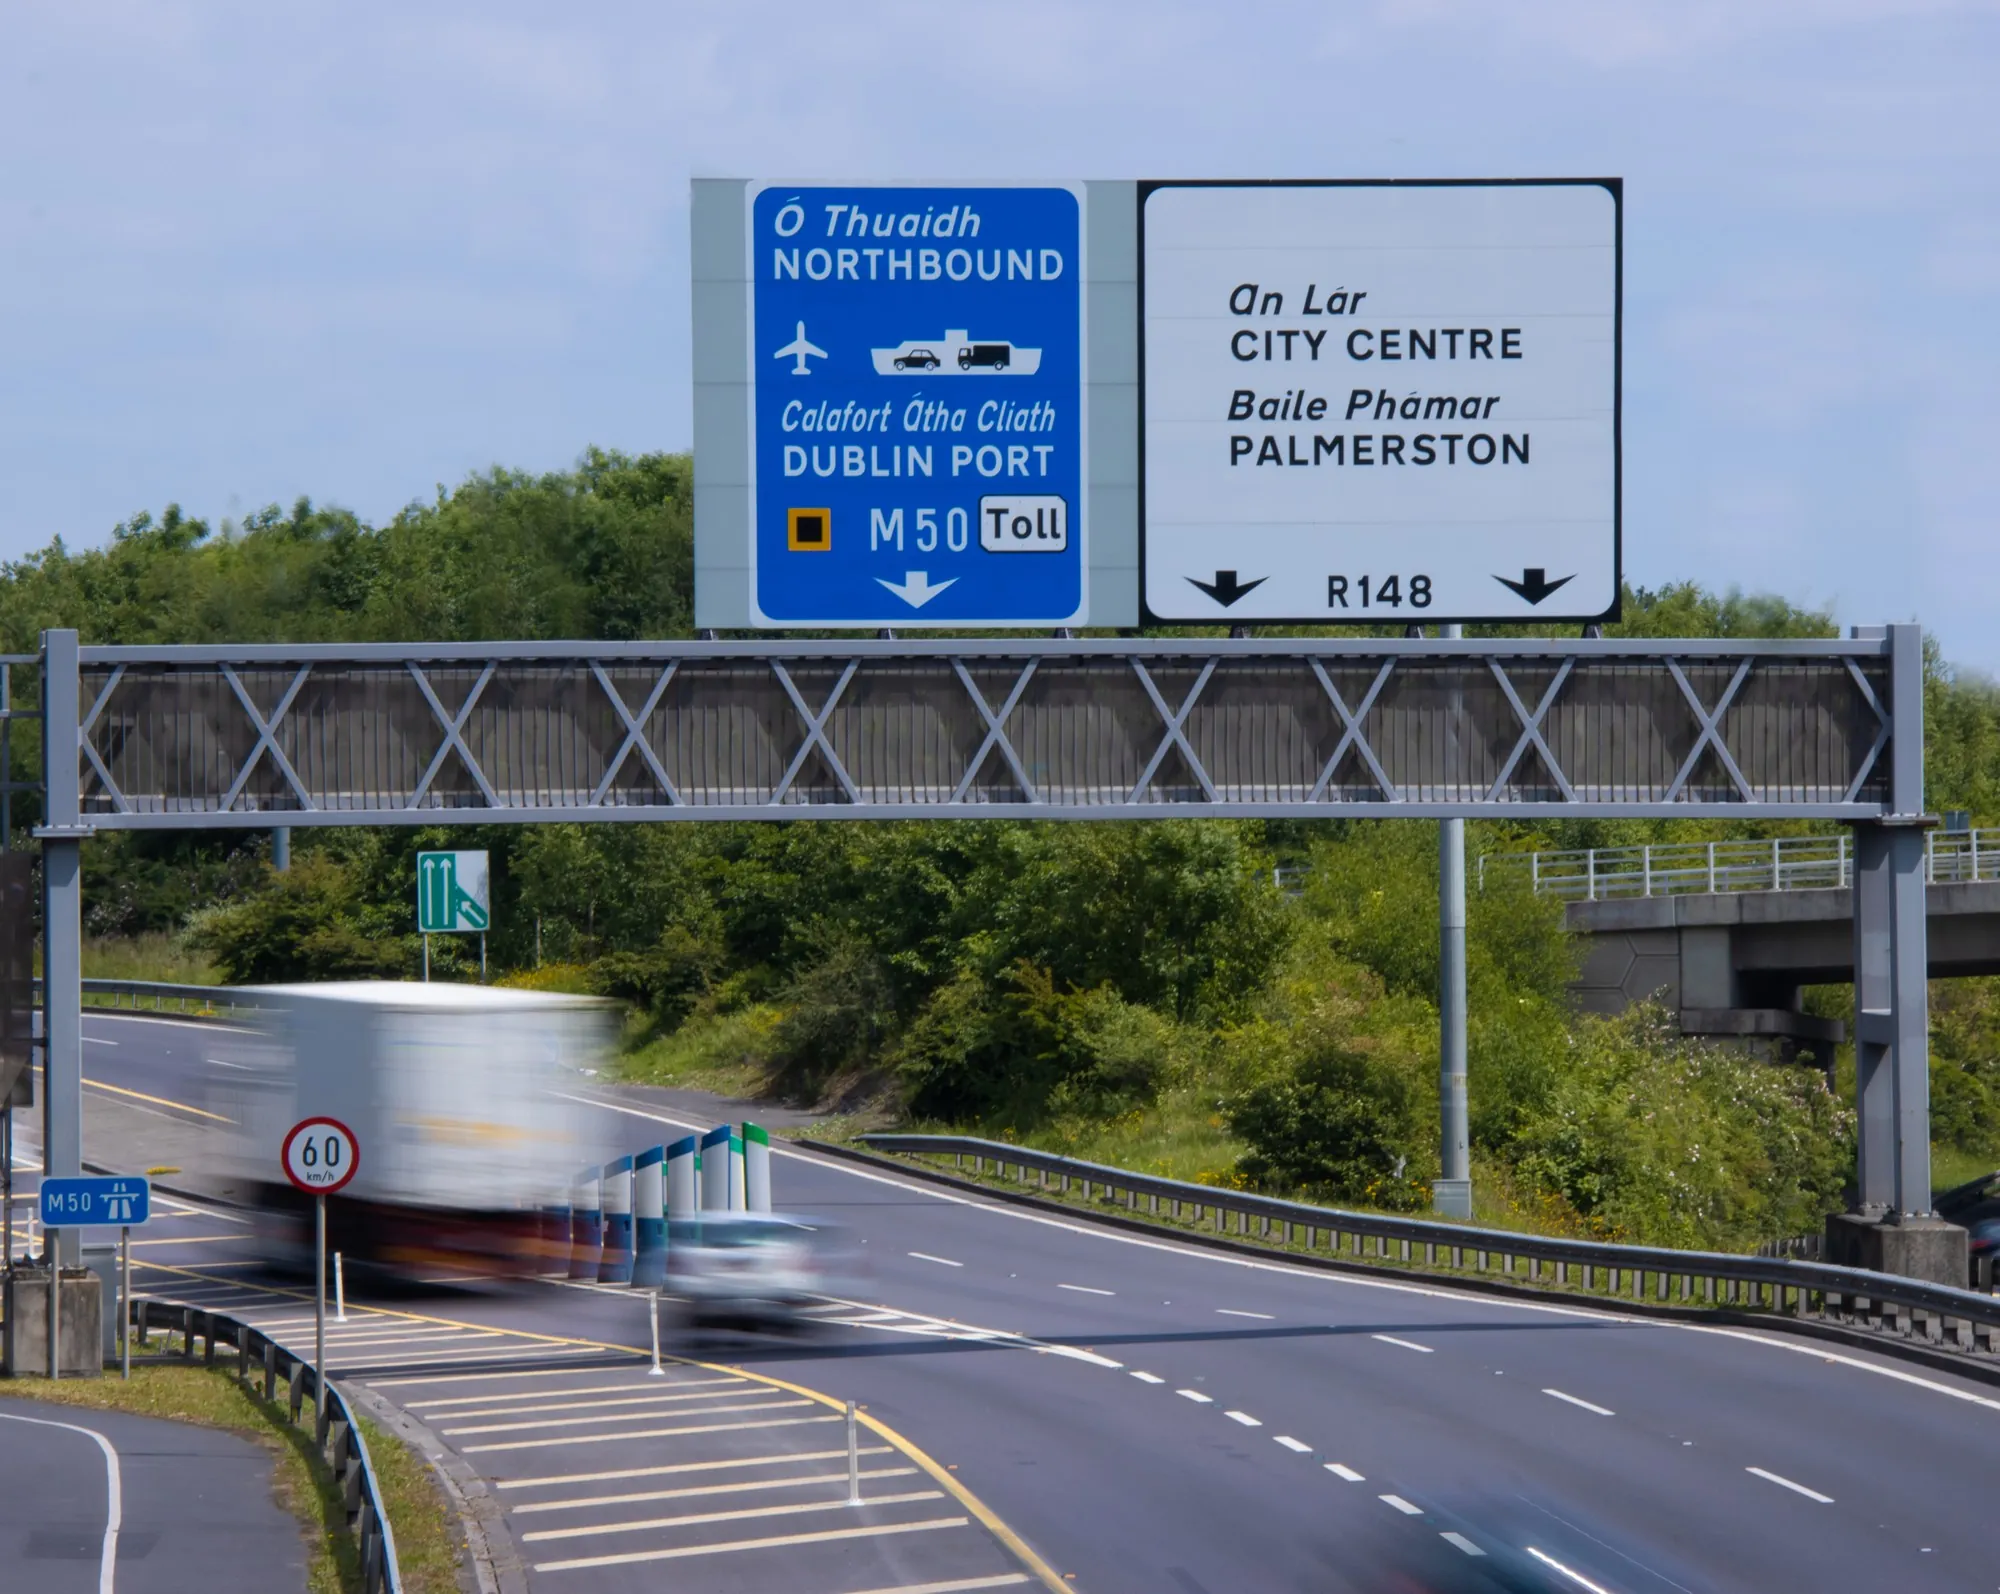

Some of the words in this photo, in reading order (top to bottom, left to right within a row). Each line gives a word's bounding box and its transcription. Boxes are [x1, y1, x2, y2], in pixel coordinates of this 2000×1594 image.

[774, 196, 804, 237] Ó
[824, 205, 981, 237] Thuaidh
[774, 248, 1064, 281] NORTHBOUND
[1228, 284, 1283, 316] An
[1302, 284, 1367, 315] Lár
[1231, 330, 1328, 361] CITY
[1346, 329, 1523, 361] CENTRE
[781, 400, 892, 432] Calafort
[903, 391, 966, 432] Átha
[977, 401, 1056, 432] Cliath
[1228, 390, 1328, 421] Baile
[1345, 389, 1501, 420] Phámar
[784, 445, 933, 477] DUBLIN
[951, 445, 1054, 477] PORT
[1230, 434, 1530, 466] PALMERSTON
[870, 507, 968, 552] M50
[986, 508, 1061, 540] Toll
[1328, 575, 1432, 608] R148
[302, 1136, 339, 1167] 60
[306, 1171, 335, 1183] km/h
[48, 1193, 91, 1212] M50
